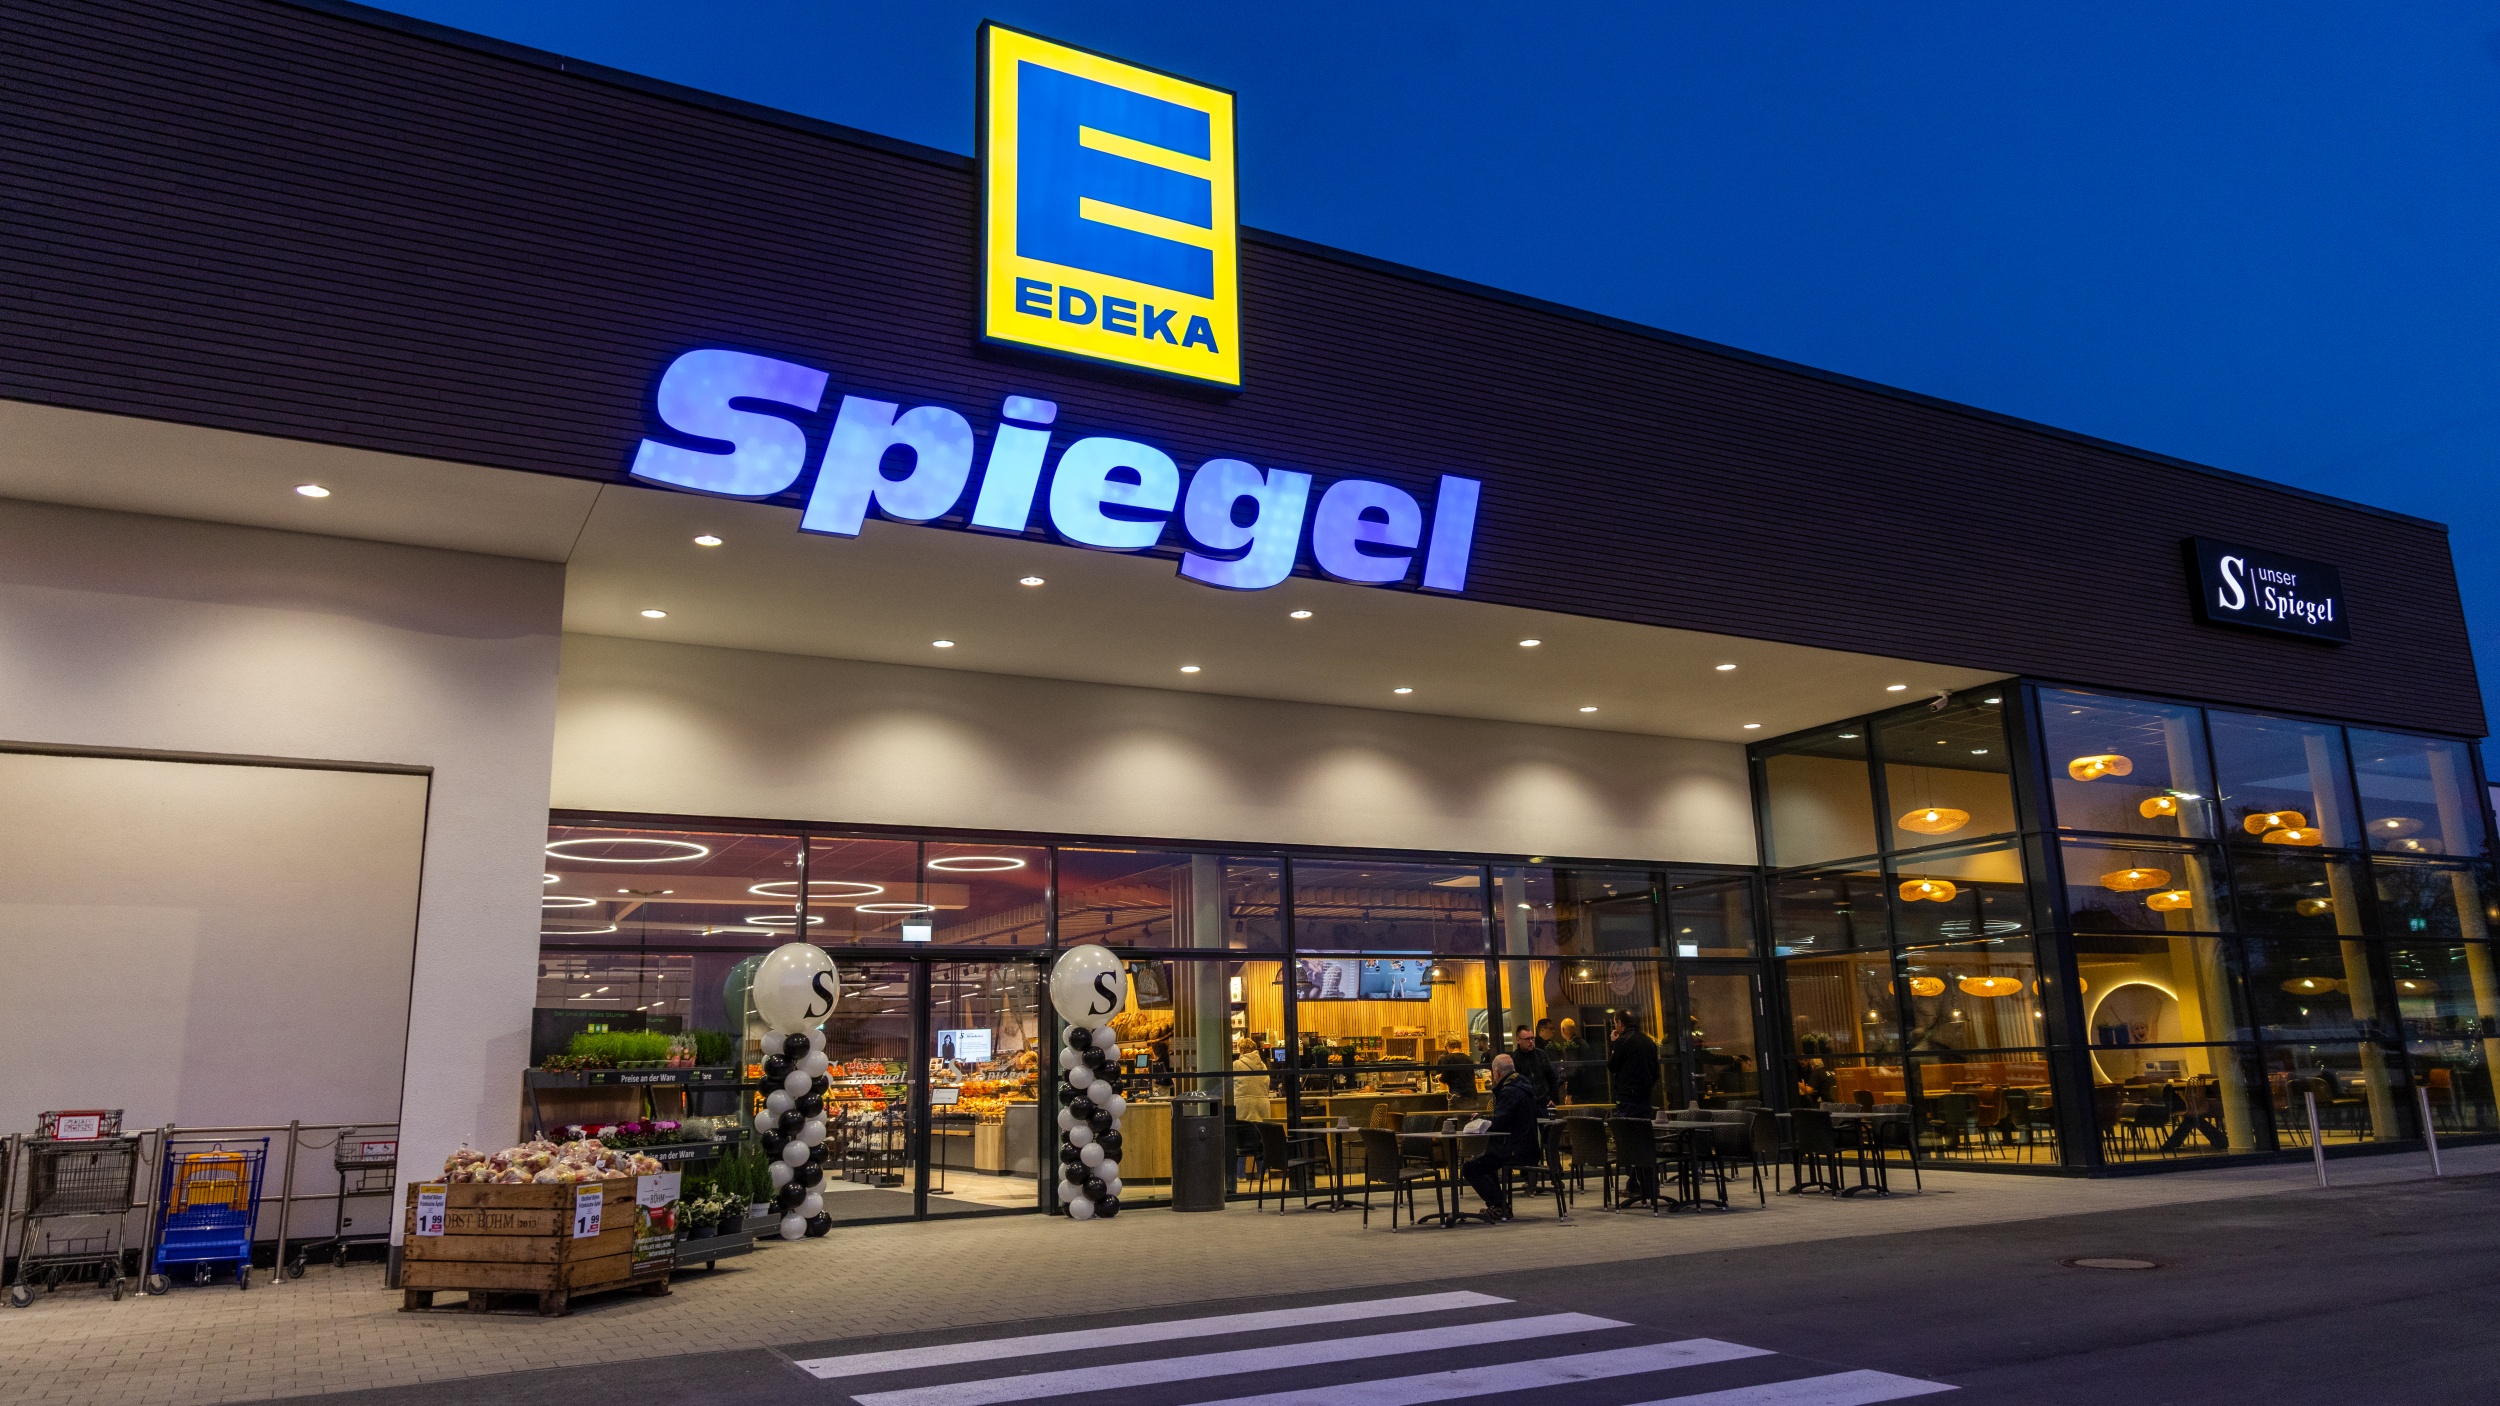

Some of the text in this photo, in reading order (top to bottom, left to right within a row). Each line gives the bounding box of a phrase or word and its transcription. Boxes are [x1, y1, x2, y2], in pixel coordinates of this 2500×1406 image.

[1017, 60, 1214, 300] E
[1015, 276, 1219, 354] EDEKA
[630, 348, 1480, 592] Spiegel
[2218, 555, 2246, 610] S
[2258, 567, 2297, 586] unser
[2264, 586, 2334, 625] Spiegel
[803, 969, 834, 1019] S
[1088, 970, 1117, 1016] S
[620, 1074, 639, 1083] Preise
[649, 1073, 659, 1082] der
[660, 1073, 676, 1081] Ware
[849, 1070, 908, 1088] Spiegel
[942, 1057, 966, 1085] S
[978, 1068, 1030, 1083] Spiegel
[659, 1152, 667, 1160] an
[667, 1151, 677, 1160] der
[678, 1150, 695, 1159] Ware
[444, 1213, 473, 1228] OBST
